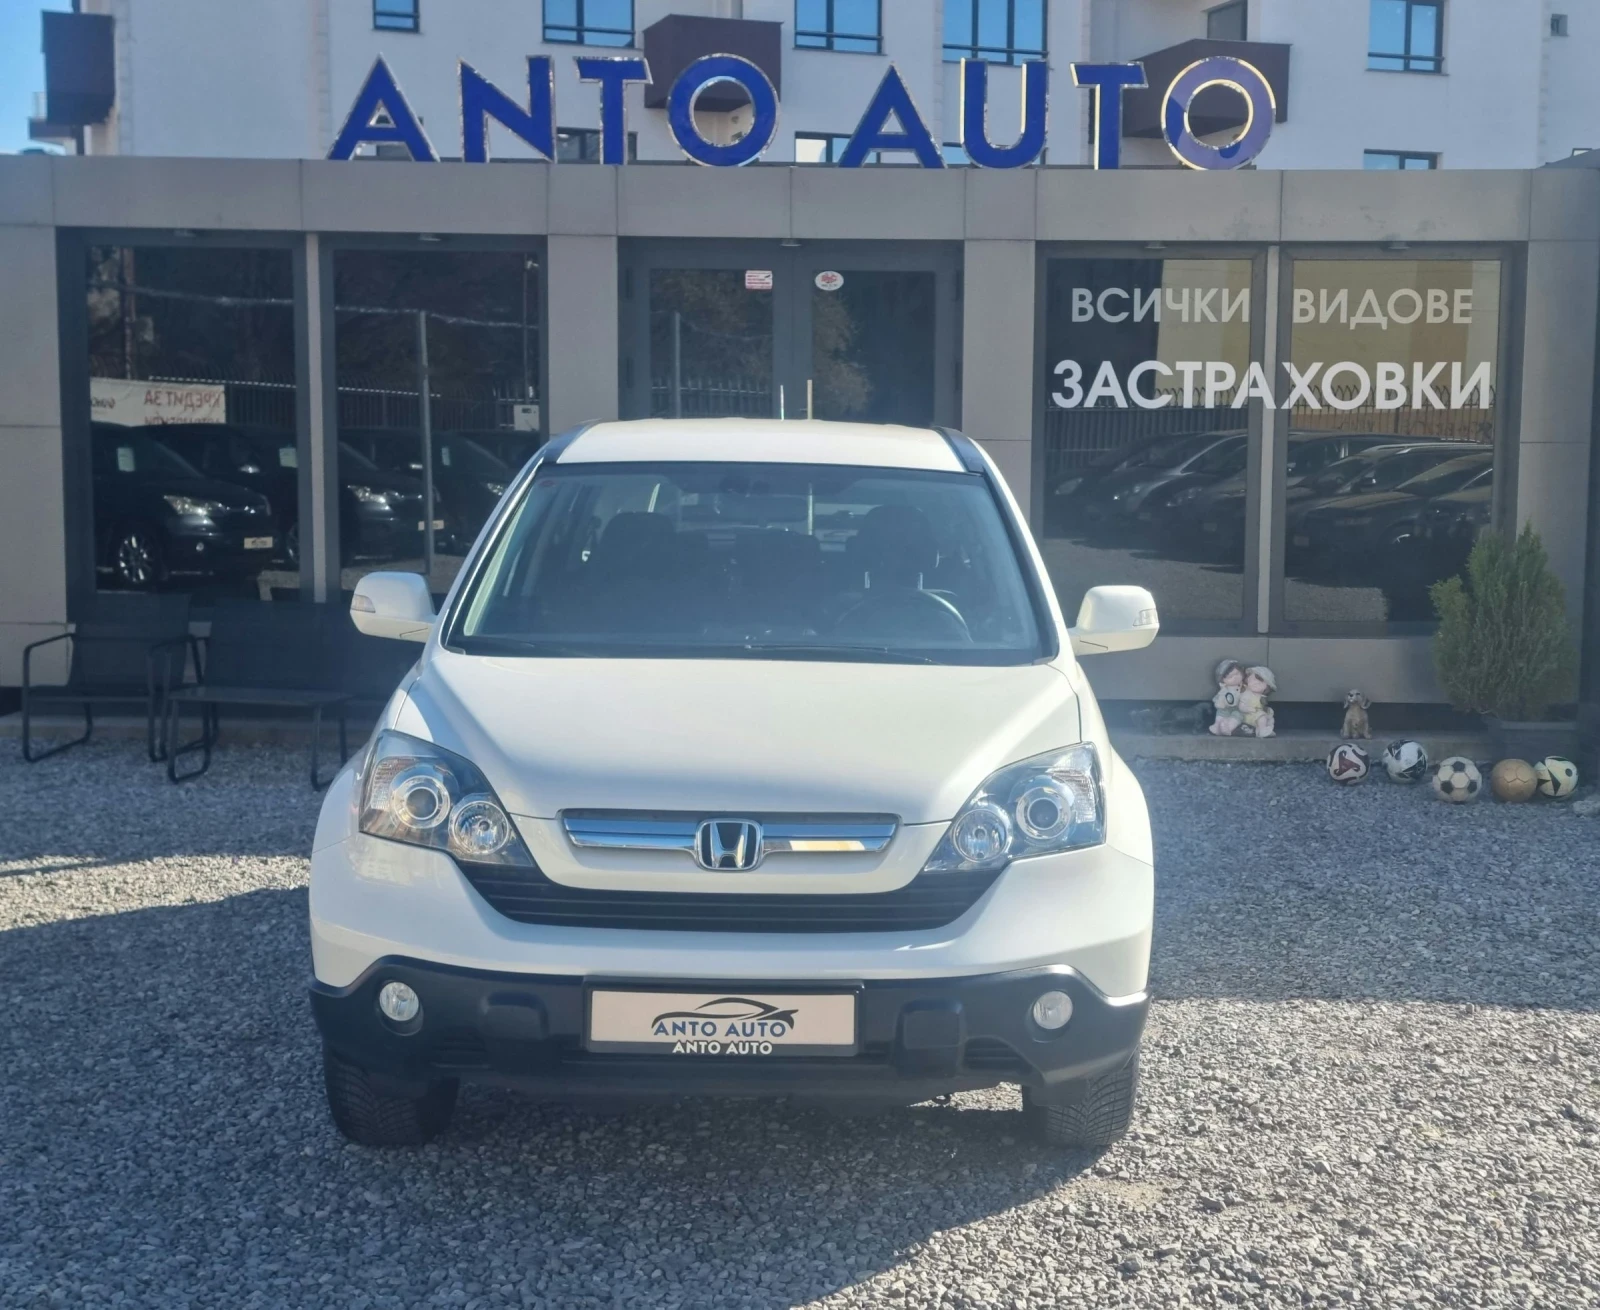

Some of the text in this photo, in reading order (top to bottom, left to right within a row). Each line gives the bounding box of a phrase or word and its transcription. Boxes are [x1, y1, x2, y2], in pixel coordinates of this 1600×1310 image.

[325, 52, 1277, 170] ANTO AUTO
[1071, 287, 1474, 330] ВСИЧКИ ВИДОВЕ
[1051, 359, 1491, 411] ЗАСТРАХОВКИ
[653, 1021, 787, 1038] ANTO AUTO
[672, 1040, 773, 1055] ANTO AUTO
